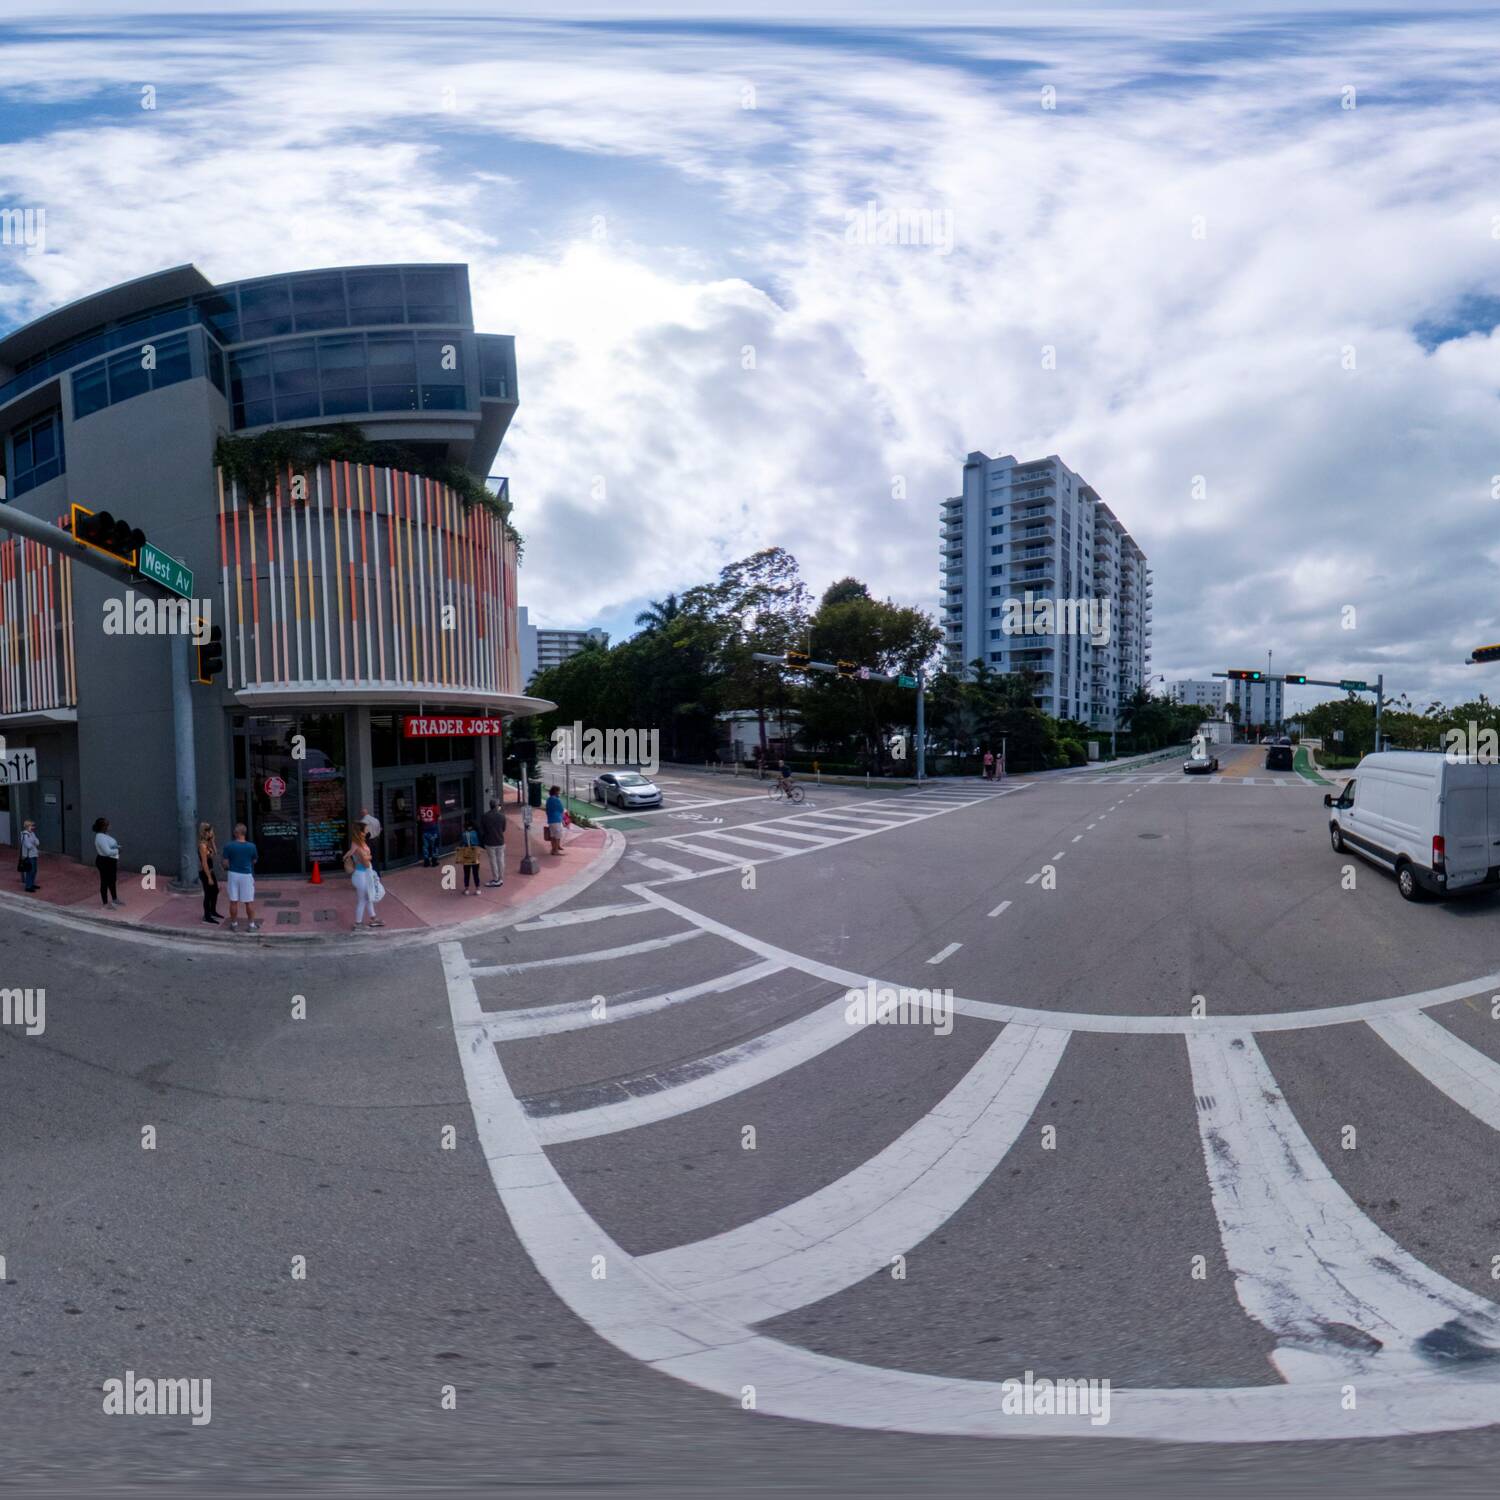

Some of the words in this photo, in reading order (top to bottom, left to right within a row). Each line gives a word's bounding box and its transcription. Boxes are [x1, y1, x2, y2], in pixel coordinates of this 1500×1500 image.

[145, 549, 170, 581] West
[176, 570, 190, 591] Av
[409, 719, 464, 735] TRADER
[467, 719, 500, 734] JOE'S
